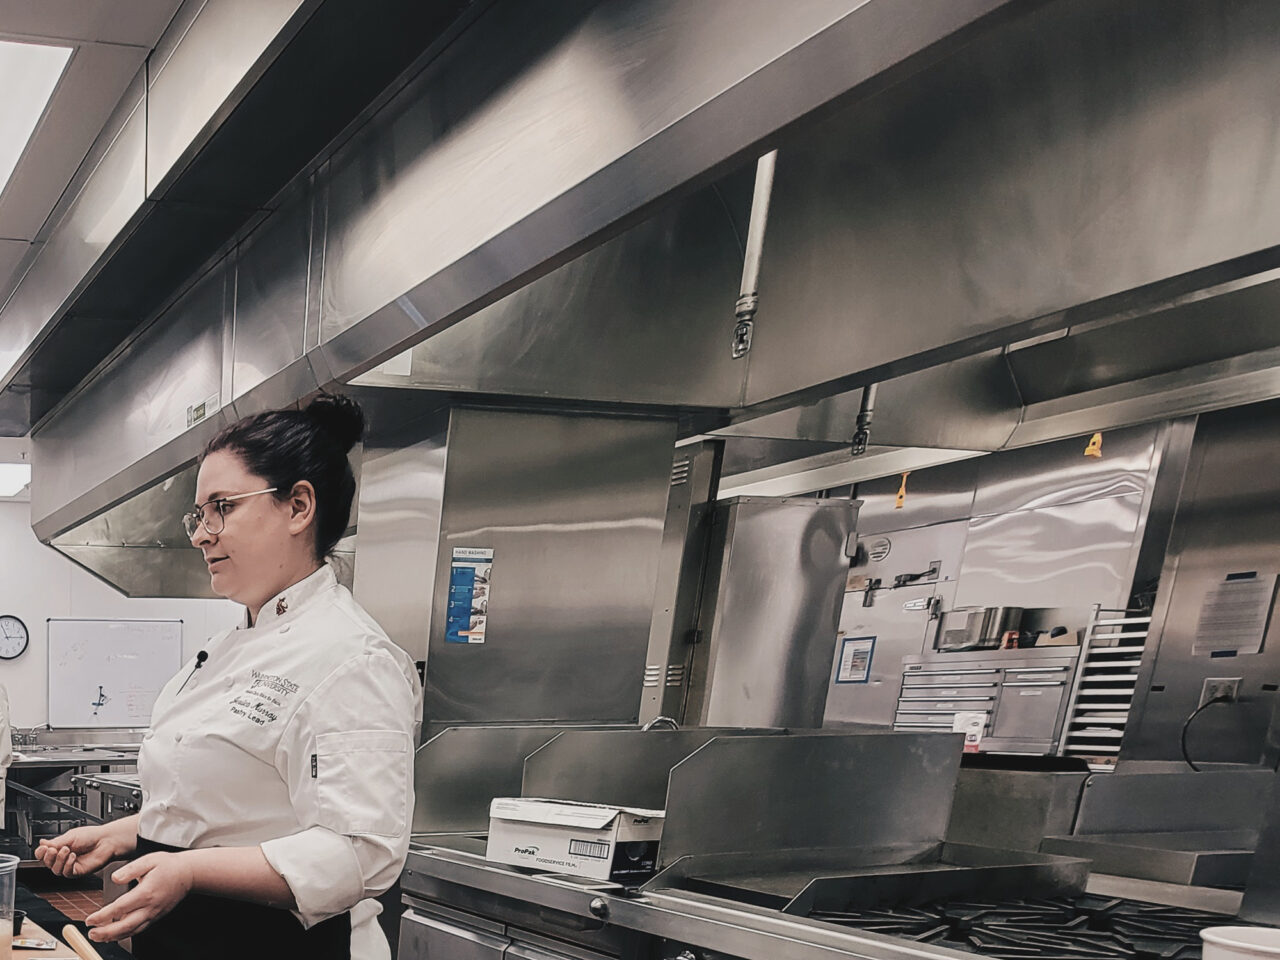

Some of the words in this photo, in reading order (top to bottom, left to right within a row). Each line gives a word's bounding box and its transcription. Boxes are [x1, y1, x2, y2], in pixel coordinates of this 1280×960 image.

[230, 706, 246, 717] Pastry
[248, 713, 265, 726] Lead
[251, 702, 278, 723] Murray
[514, 846, 536, 856] ProPak
[536, 858, 565, 867] FOODSERVICE
